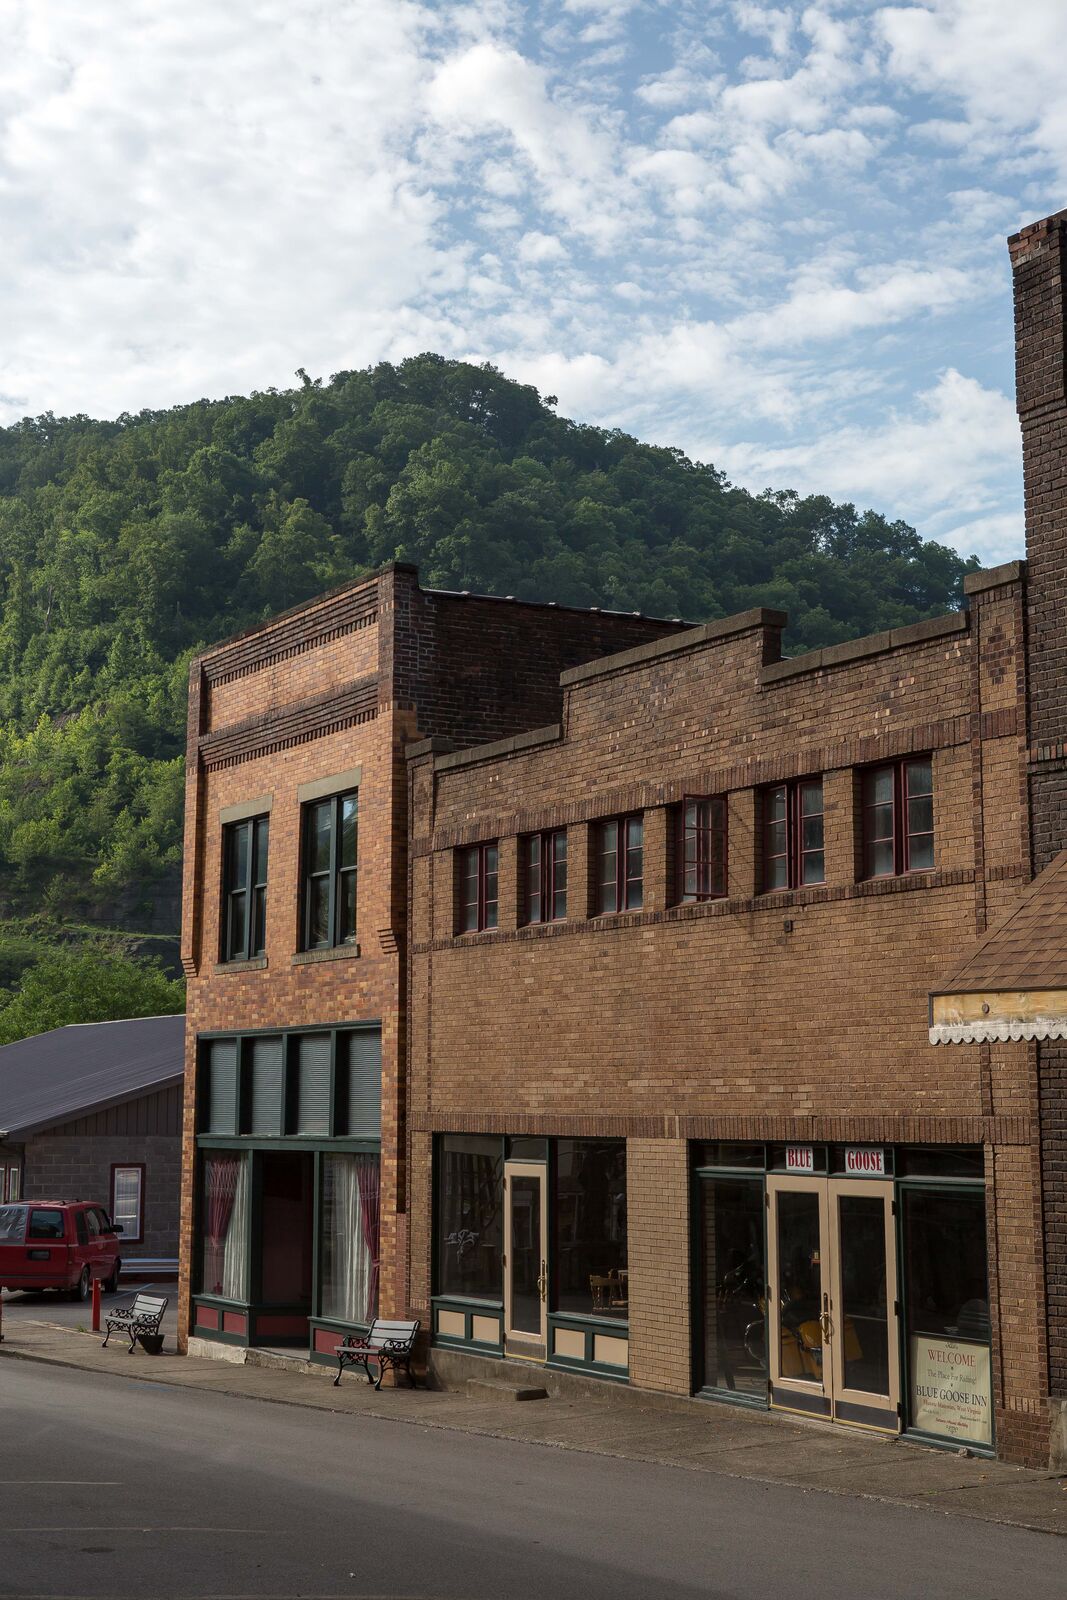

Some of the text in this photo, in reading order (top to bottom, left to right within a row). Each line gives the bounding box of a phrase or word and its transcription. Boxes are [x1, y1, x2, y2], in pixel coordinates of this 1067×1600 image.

[788, 1148, 882, 1171] BLUE GOOSE
[928, 1349, 976, 1367] WELCOME
[916, 1385, 938, 1399] BLUE
[940, 1389, 969, 1404] GOOSE
[971, 1394, 987, 1407] INN
